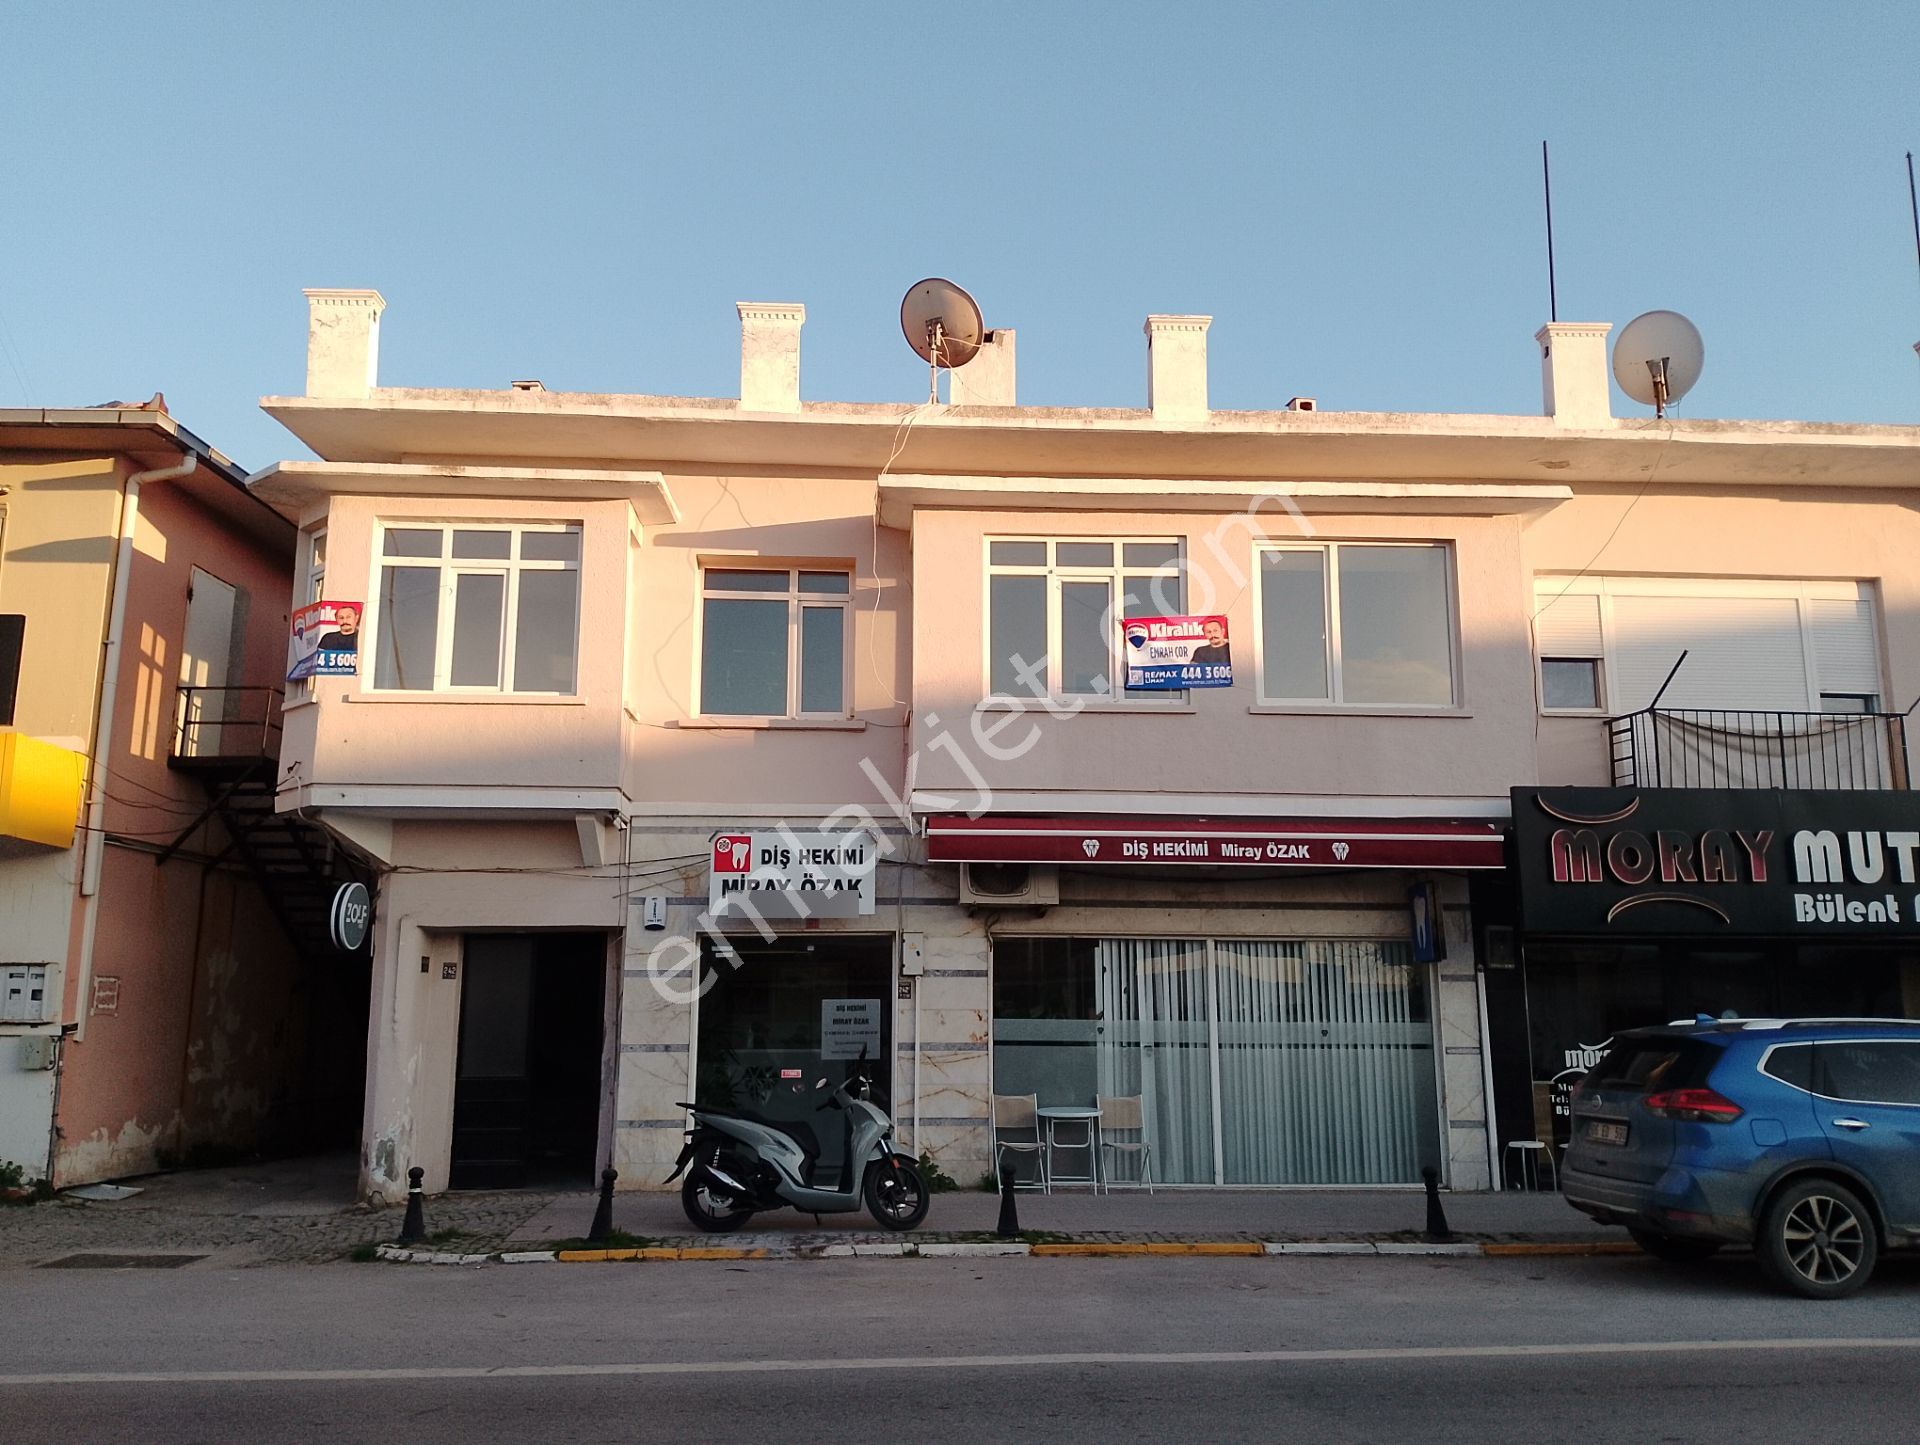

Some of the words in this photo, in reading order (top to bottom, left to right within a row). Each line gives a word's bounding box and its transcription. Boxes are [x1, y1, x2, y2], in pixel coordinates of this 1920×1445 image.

[1150, 647, 1173, 659] EMRAH
[1145, 670, 1177, 679] RE/MAX
[1181, 667, 1202, 679] 444
[761, 845, 791, 869] DİŞ
[799, 845, 864, 865] HEKİMİ
[1123, 840, 1149, 859] DİŞ
[1153, 840, 1209, 857] HEKİMİ
[1221, 843, 1262, 861] Miray
[1266, 842, 1310, 859] ÖZAK
[1550, 828, 1774, 885] MORAY
[1794, 893, 1900, 923] Bülent
[1564, 1049, 1612, 1070] mor
[1549, 1094, 1569, 1103] Tel:
